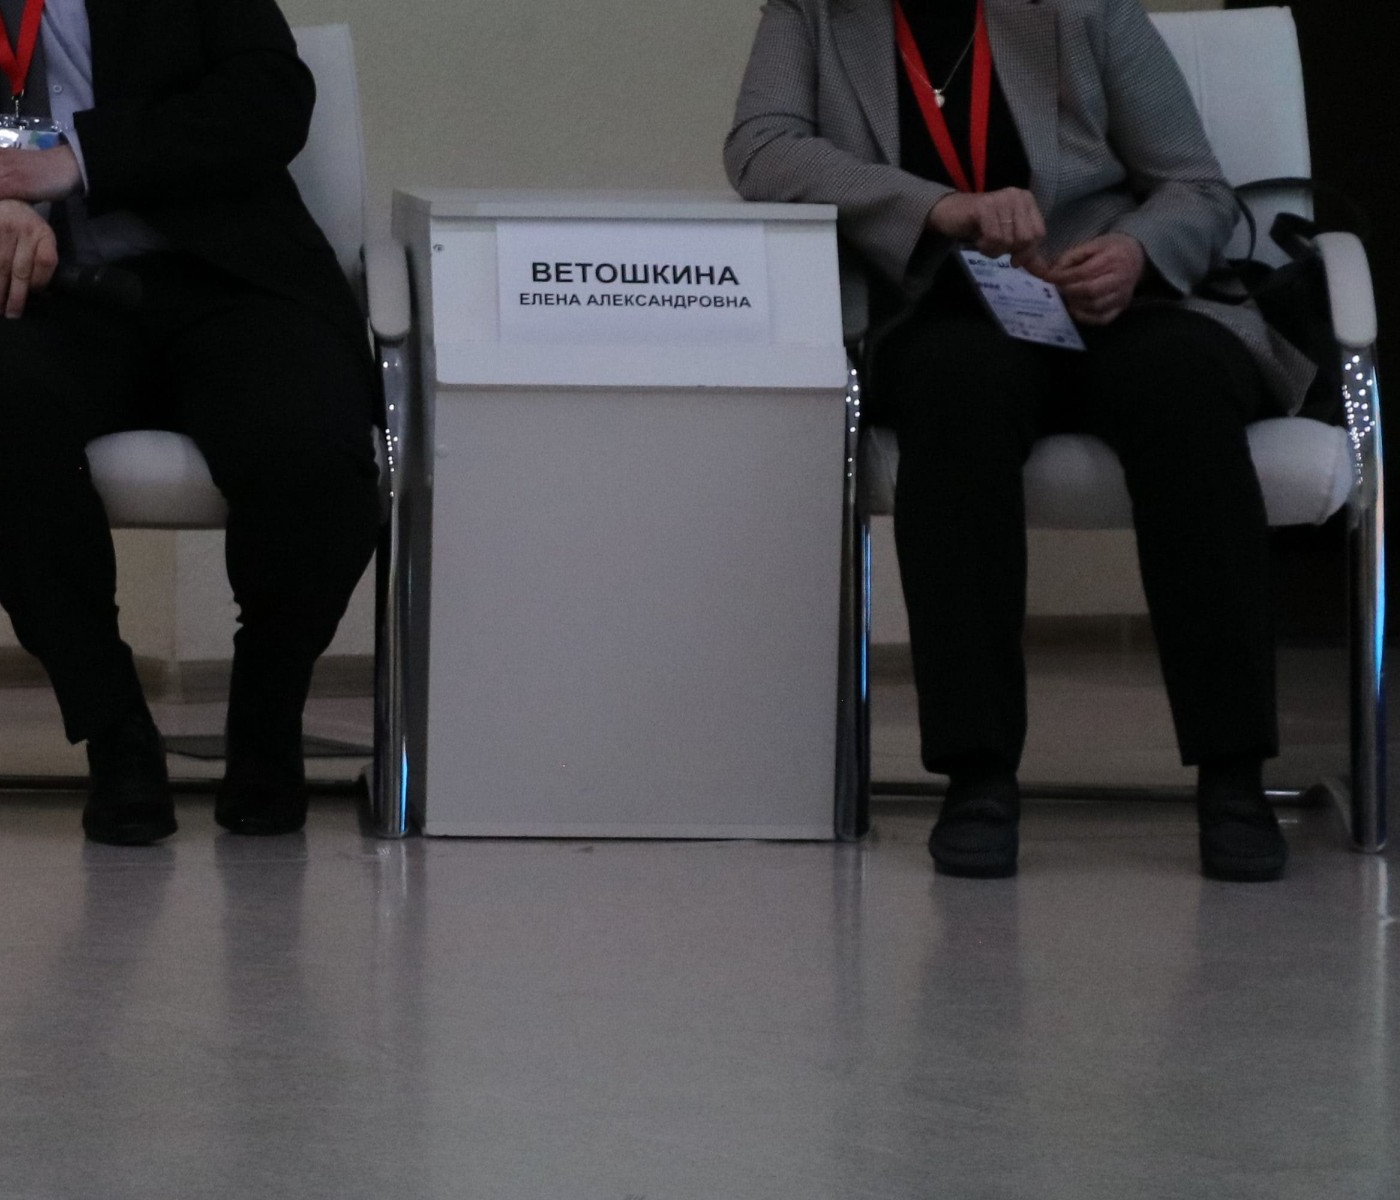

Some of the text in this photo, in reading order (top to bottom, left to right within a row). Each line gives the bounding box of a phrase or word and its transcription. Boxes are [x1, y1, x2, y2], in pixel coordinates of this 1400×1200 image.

[532, 262, 739, 285] ВЕТОШКИНА
[520, 293, 751, 309] ЕЛЕНА АЛЕКСАНДРОВНА
